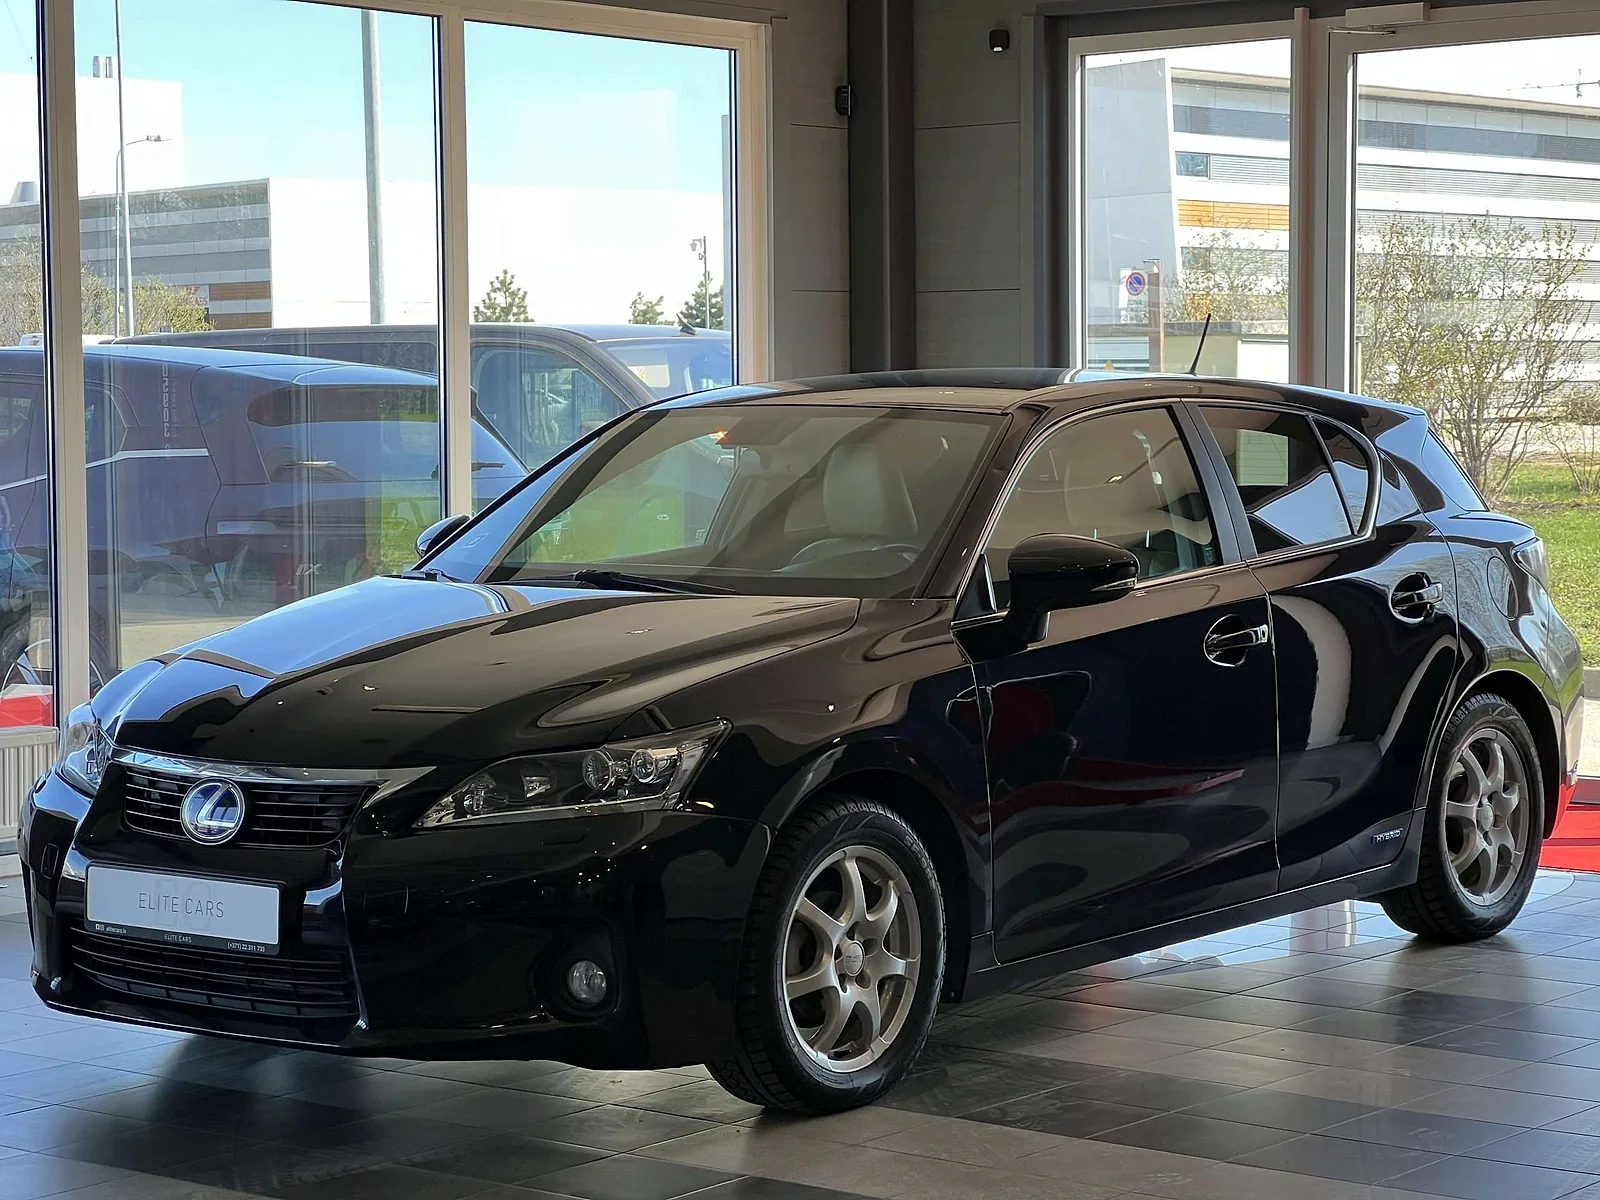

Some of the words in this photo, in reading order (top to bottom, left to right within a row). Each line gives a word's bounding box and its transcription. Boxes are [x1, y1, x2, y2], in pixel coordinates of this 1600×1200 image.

[1376, 829, 1401, 842] HYBRID
[138, 892, 179, 913] ELITE
[185, 897, 224, 918] CARS
[164, 933, 178, 942] ELITE
[178, 935, 192, 943] CARS
[227, 941, 241, 951] (+371)
